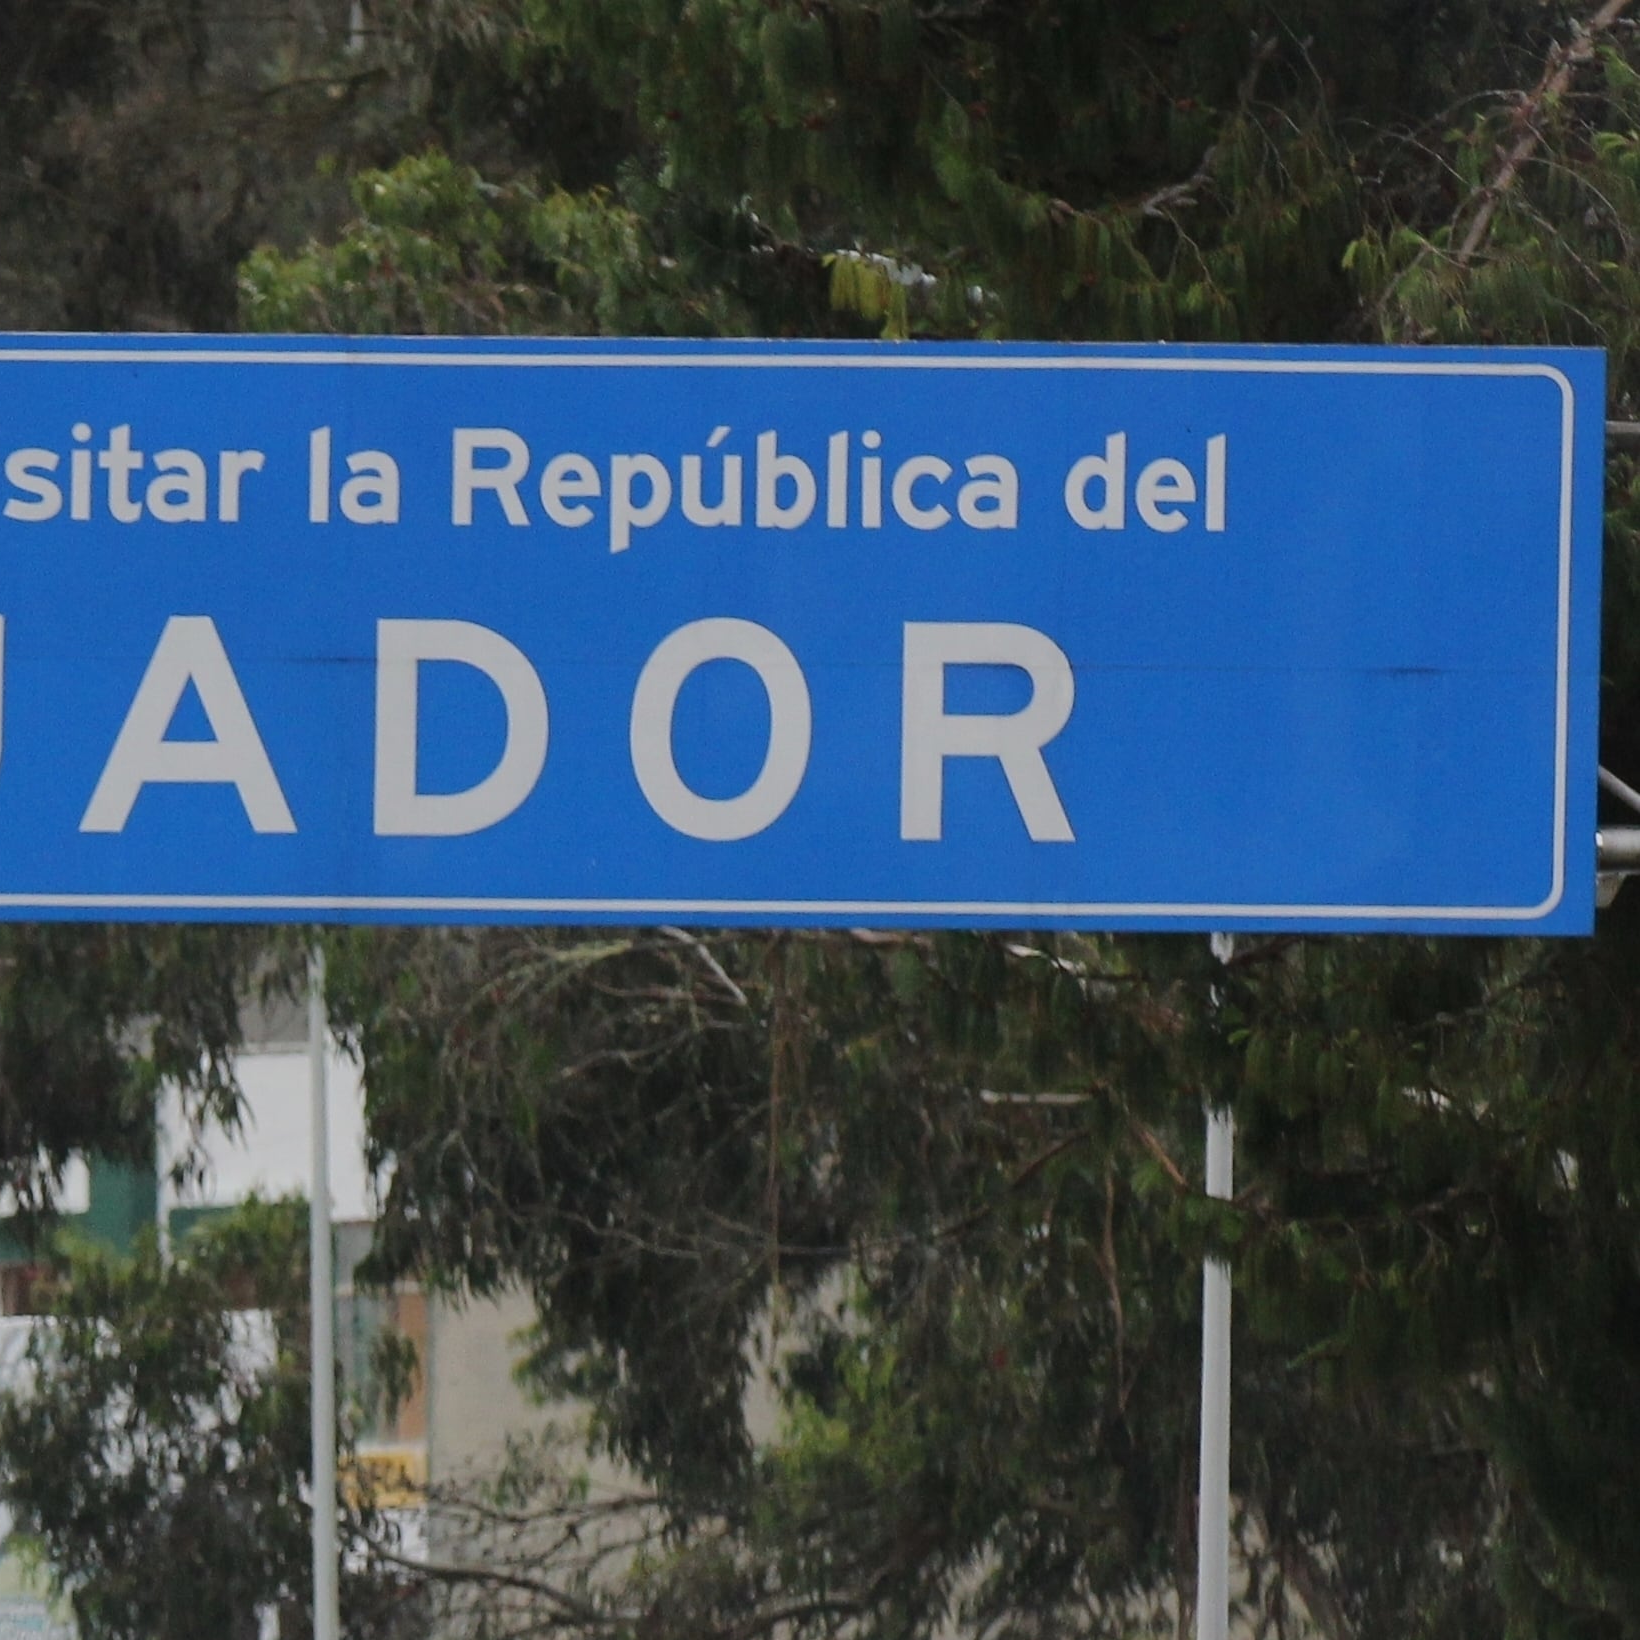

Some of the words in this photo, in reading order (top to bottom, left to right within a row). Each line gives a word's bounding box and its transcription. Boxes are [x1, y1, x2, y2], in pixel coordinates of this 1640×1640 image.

[309, 426, 401, 525] la
[452, 426, 1020, 554] República
[1064, 431, 1227, 534] del
